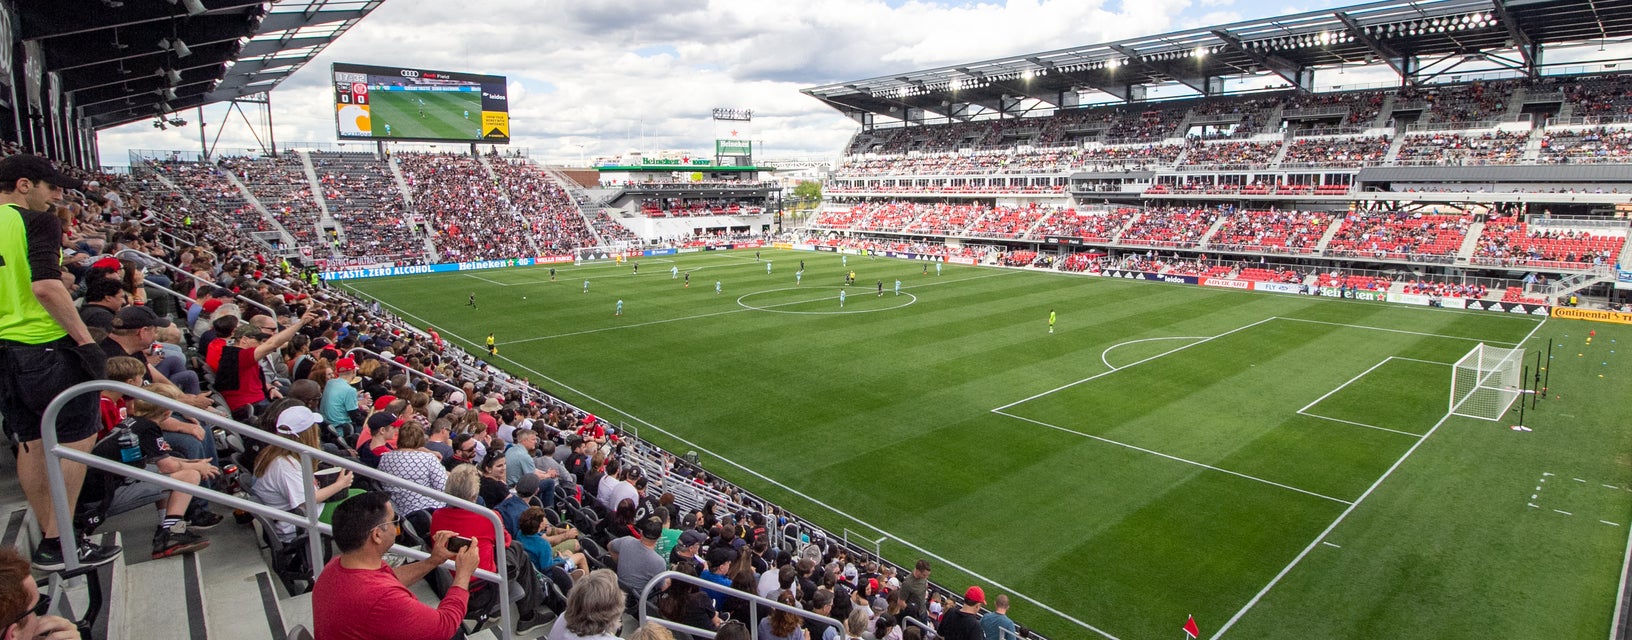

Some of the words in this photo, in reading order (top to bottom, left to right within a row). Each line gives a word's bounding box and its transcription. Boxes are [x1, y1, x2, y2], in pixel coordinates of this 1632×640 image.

[341, 94, 349, 103] 0
[357, 95, 365, 104] 0
[642, 157, 679, 165] Heineken
[326, 258, 349, 267] DISTRICT
[357, 256, 377, 266] ULTRAS
[459, 260, 507, 271] Heineken
[369, 267, 392, 277] ZERO
[394, 265, 435, 275] ALCOHOL.
[1164, 275, 1185, 284] leidos
[1554, 307, 1611, 319] Continental
[88, 515, 100, 524] 16
